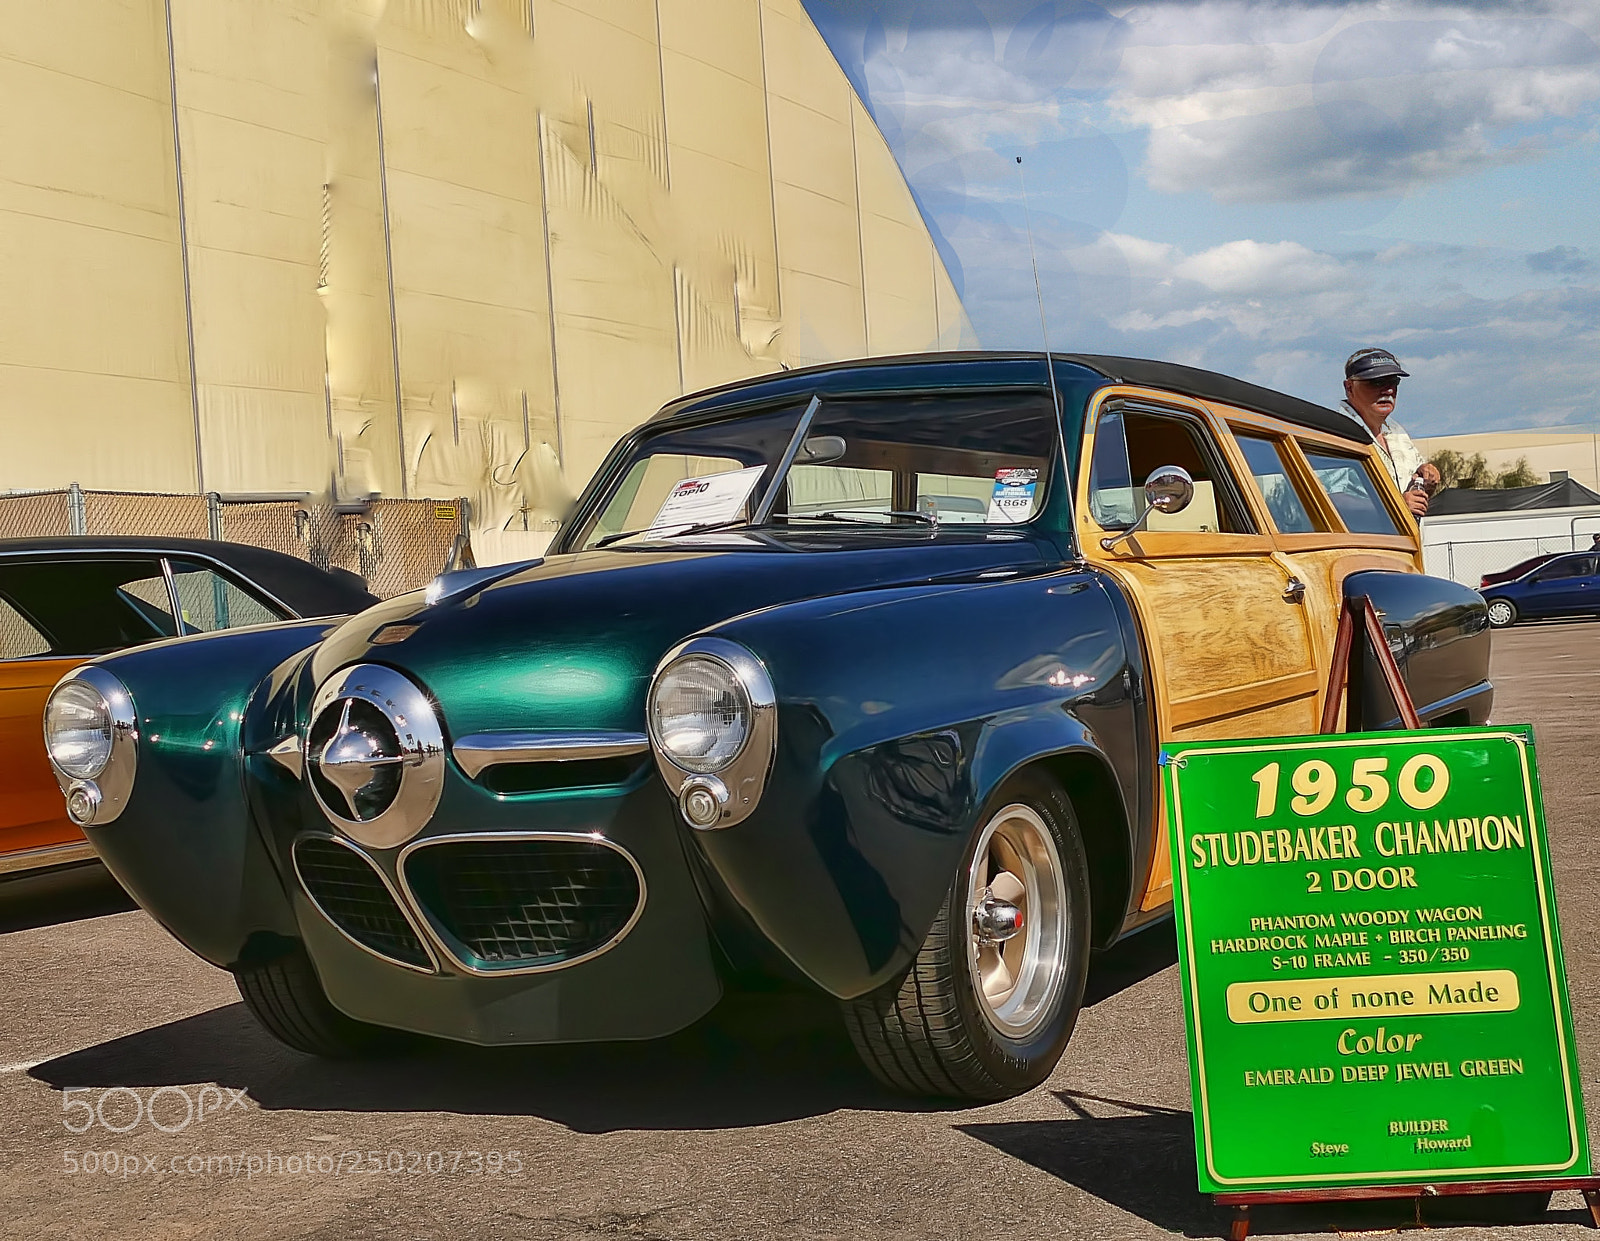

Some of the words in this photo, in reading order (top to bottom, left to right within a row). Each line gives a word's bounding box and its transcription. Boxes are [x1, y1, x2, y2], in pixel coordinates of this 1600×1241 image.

[1251, 753, 1450, 819] 1950
[1191, 825, 1361, 868] STUDEBAKER
[1375, 816, 1524, 856] CHAMPION
[1306, 872, 1321, 892] 2
[1333, 867, 1417, 890] DOOR
[1251, 914, 1335, 930] PHANTOM
[1341, 911, 1409, 925] WOODY
[1416, 907, 1482, 922] WAGON
[1212, 935, 1307, 952] HARDROCK
[1316, 932, 1368, 947] MAPLE
[1390, 929, 1440, 943] BIRCH
[1448, 924, 1527, 940] PANELING
[1273, 956, 1307, 969] S-10
[1314, 952, 1370, 967] FRAME
[1399, 947, 1470, 964] 350/350
[1249, 992, 1301, 1013] One
[1314, 988, 1338, 1009] of
[1352, 991, 1413, 1007] none
[1429, 981, 1498, 1004] Made
[1338, 1028, 1422, 1054] Color
[1245, 1068, 1334, 1085] EMERALD
[1343, 1065, 1388, 1081] DEEP
[1397, 1062, 1453, 1081] JEWEL
[1461, 1059, 1523, 1076] GREEN
[1390, 1120, 1448, 1133] BUILDER
[1313, 1143, 1348, 1154] Steve
[1418, 1136, 1471, 1149] Howard
